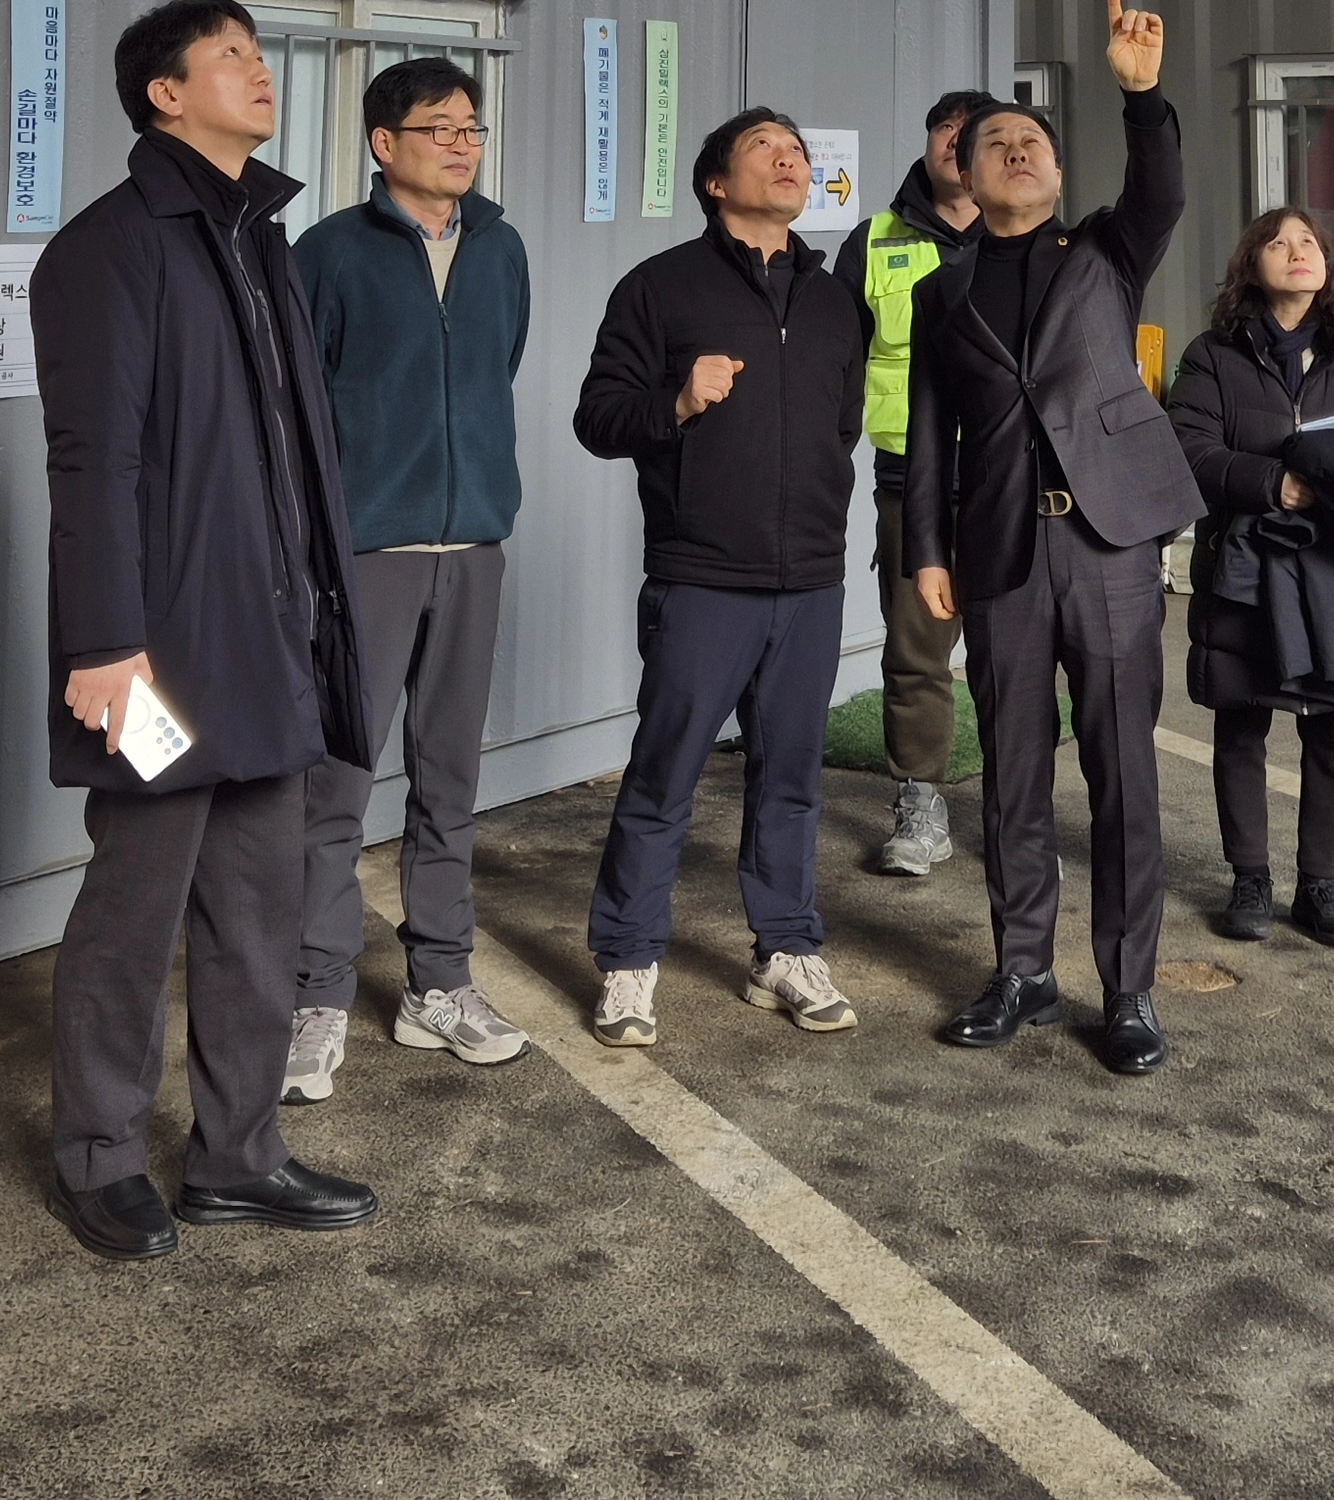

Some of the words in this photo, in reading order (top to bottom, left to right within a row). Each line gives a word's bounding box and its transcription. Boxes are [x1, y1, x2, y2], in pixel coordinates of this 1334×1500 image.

[44, 5, 59, 62] 마음마다
[16, 88, 38, 145] 손길마다
[43, 67, 58, 124] 자원절약
[597, 98, 610, 122] 적게
[14, 151, 37, 207] 환경보호
[655, 147, 668, 198] 안전입니다
